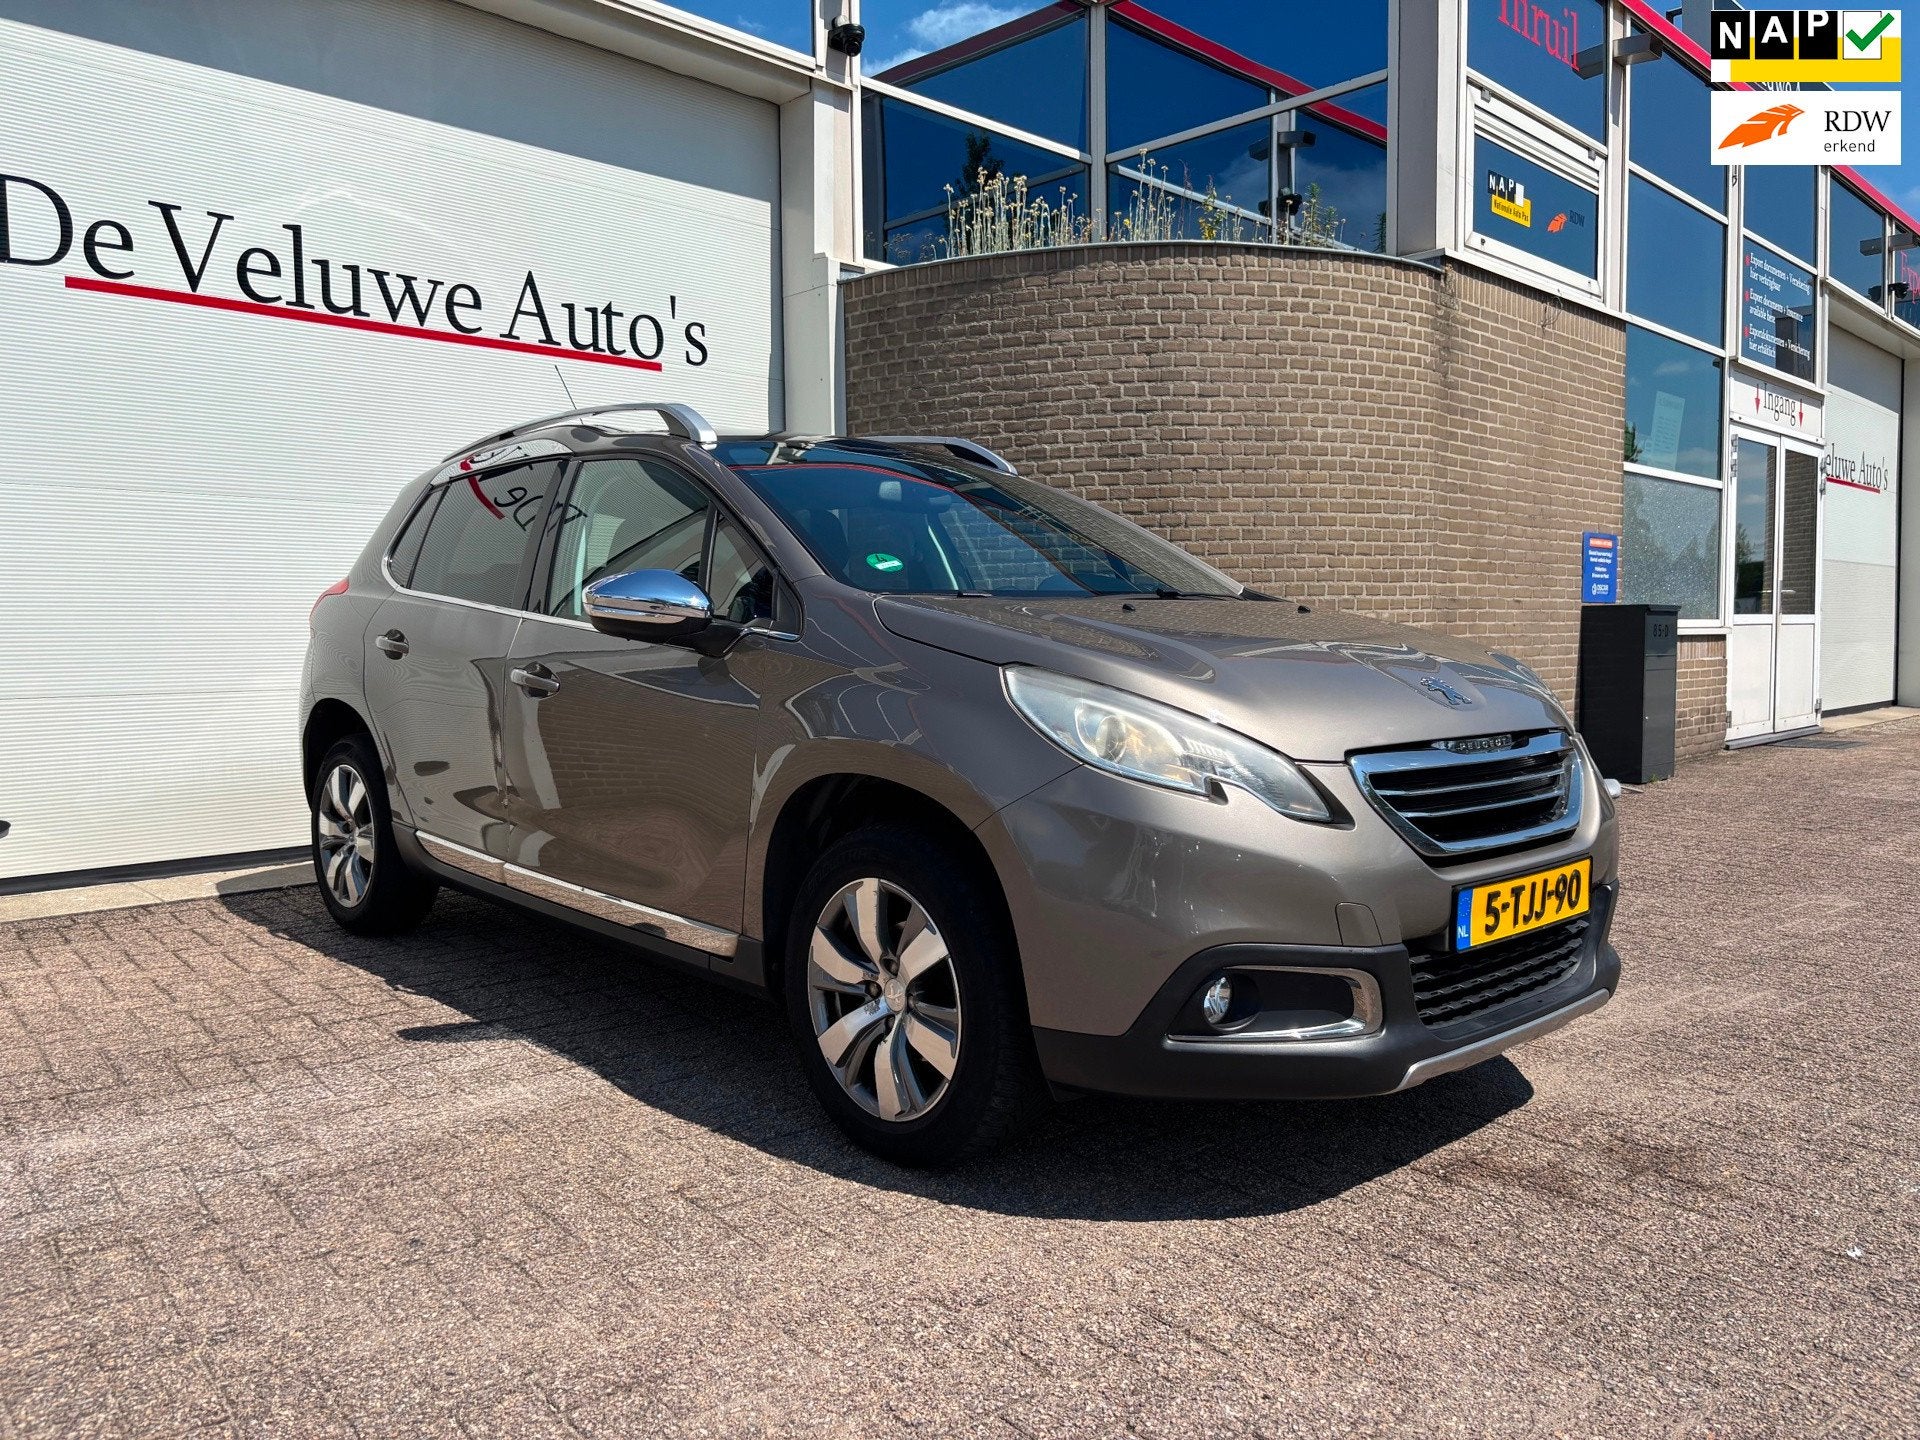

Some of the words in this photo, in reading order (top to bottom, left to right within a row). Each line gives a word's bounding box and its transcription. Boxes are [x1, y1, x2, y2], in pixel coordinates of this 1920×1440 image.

[1489, 174, 1514, 192] NAP
[1494, 200, 1513, 215] Nationale
[1569, 209, 1585, 227] RDW
[0, 173, 135, 280] De
[148, 200, 482, 334] Veluwe
[500, 270, 708, 366] Auto's
[1763, 383, 1796, 426] Ingang
[1825, 443, 1855, 483] eluwe
[1858, 451, 1888, 490] Auto's
[1485, 869, 1581, 936] 5-TJJ-90
[1457, 925, 1469, 939] NL
